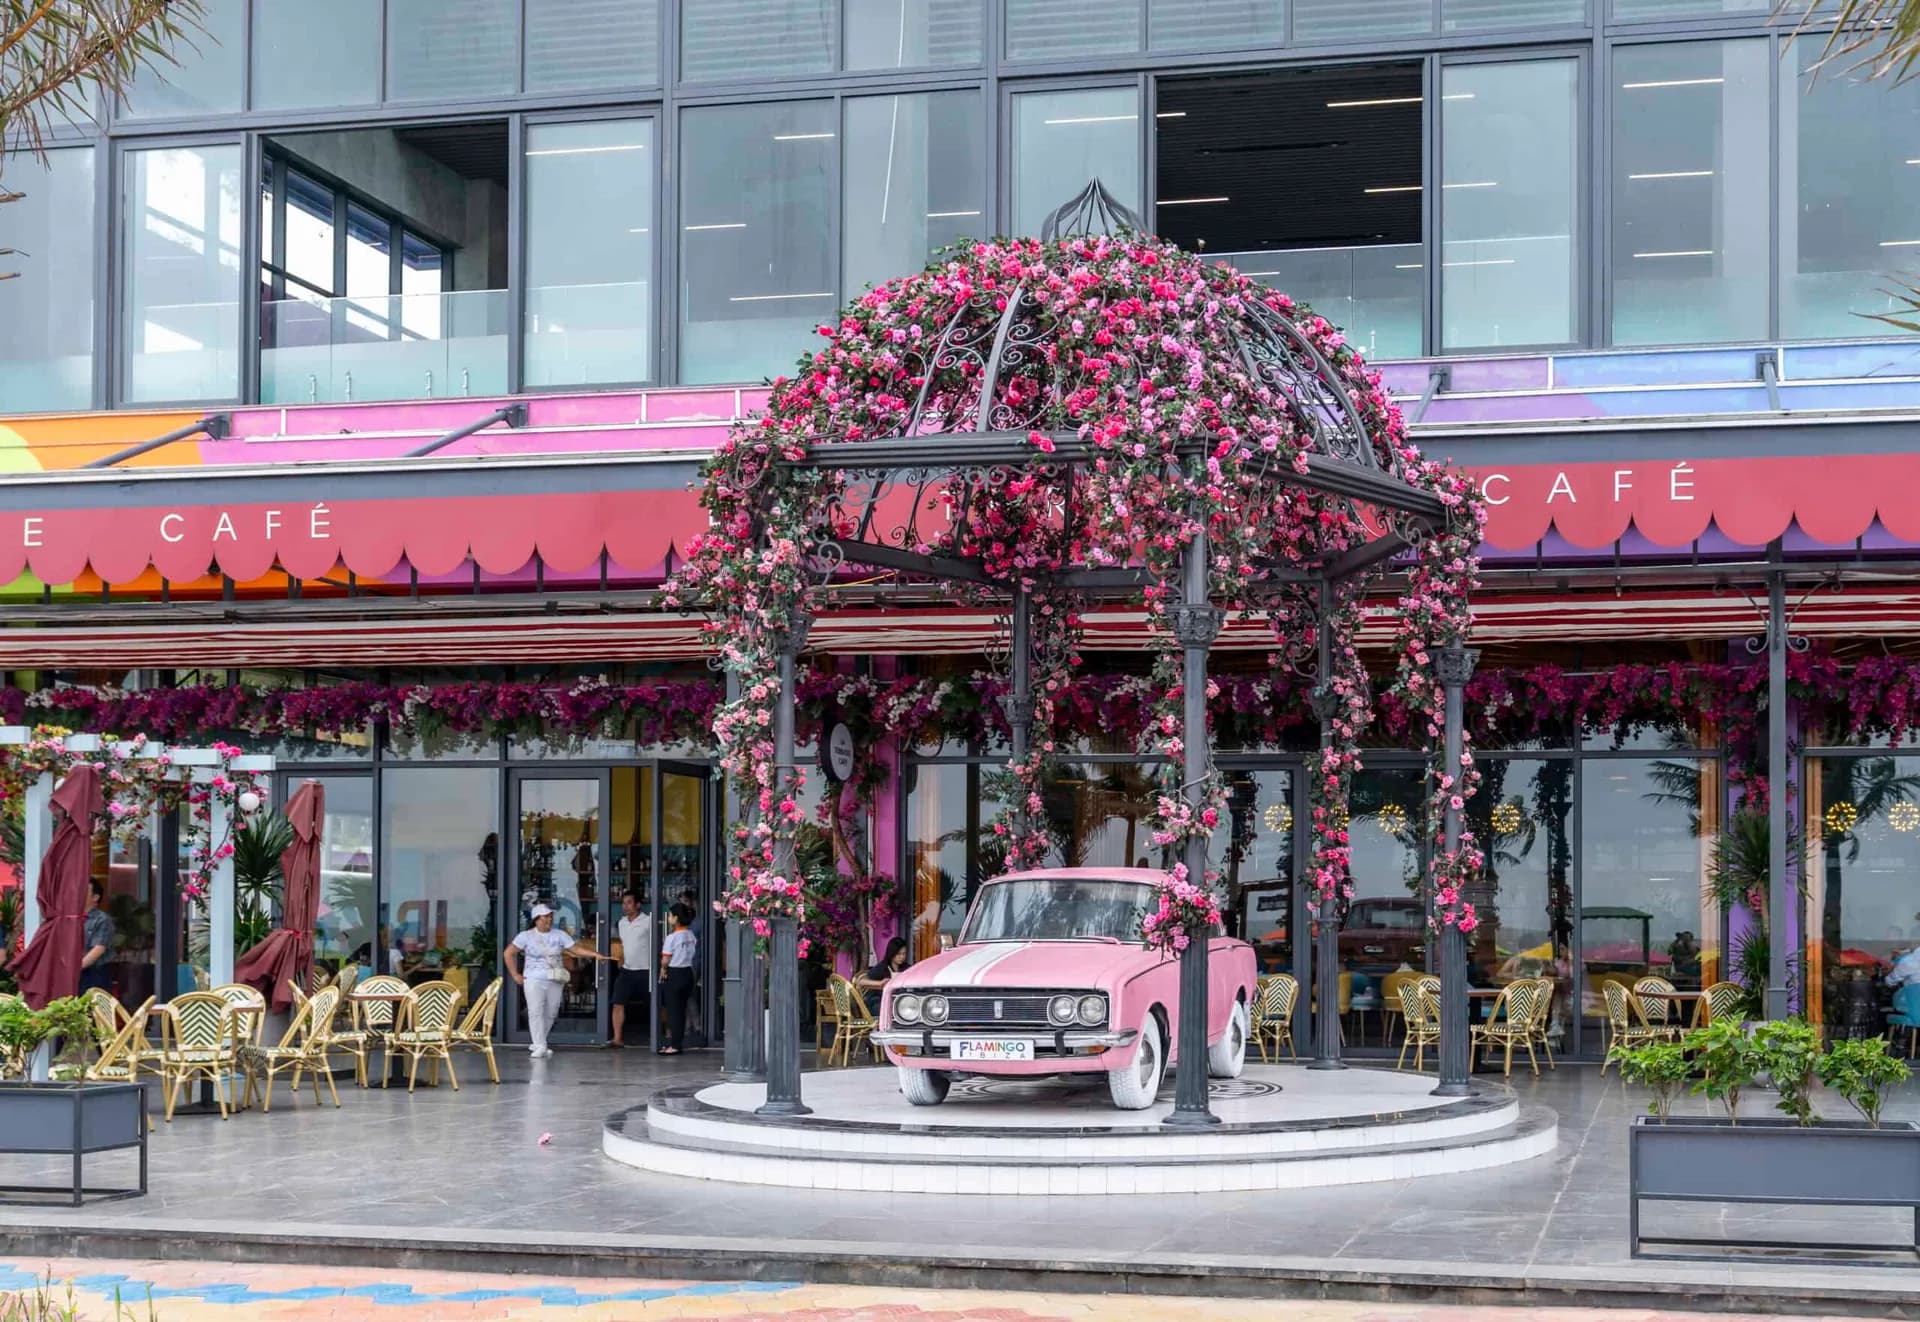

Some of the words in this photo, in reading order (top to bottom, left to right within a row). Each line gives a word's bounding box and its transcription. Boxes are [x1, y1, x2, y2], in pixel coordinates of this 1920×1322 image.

[1482, 461, 1694, 505] CAFÉ
[159, 502, 330, 542] CAFÉ
[959, 1041, 1026, 1057] FLAMINGO
